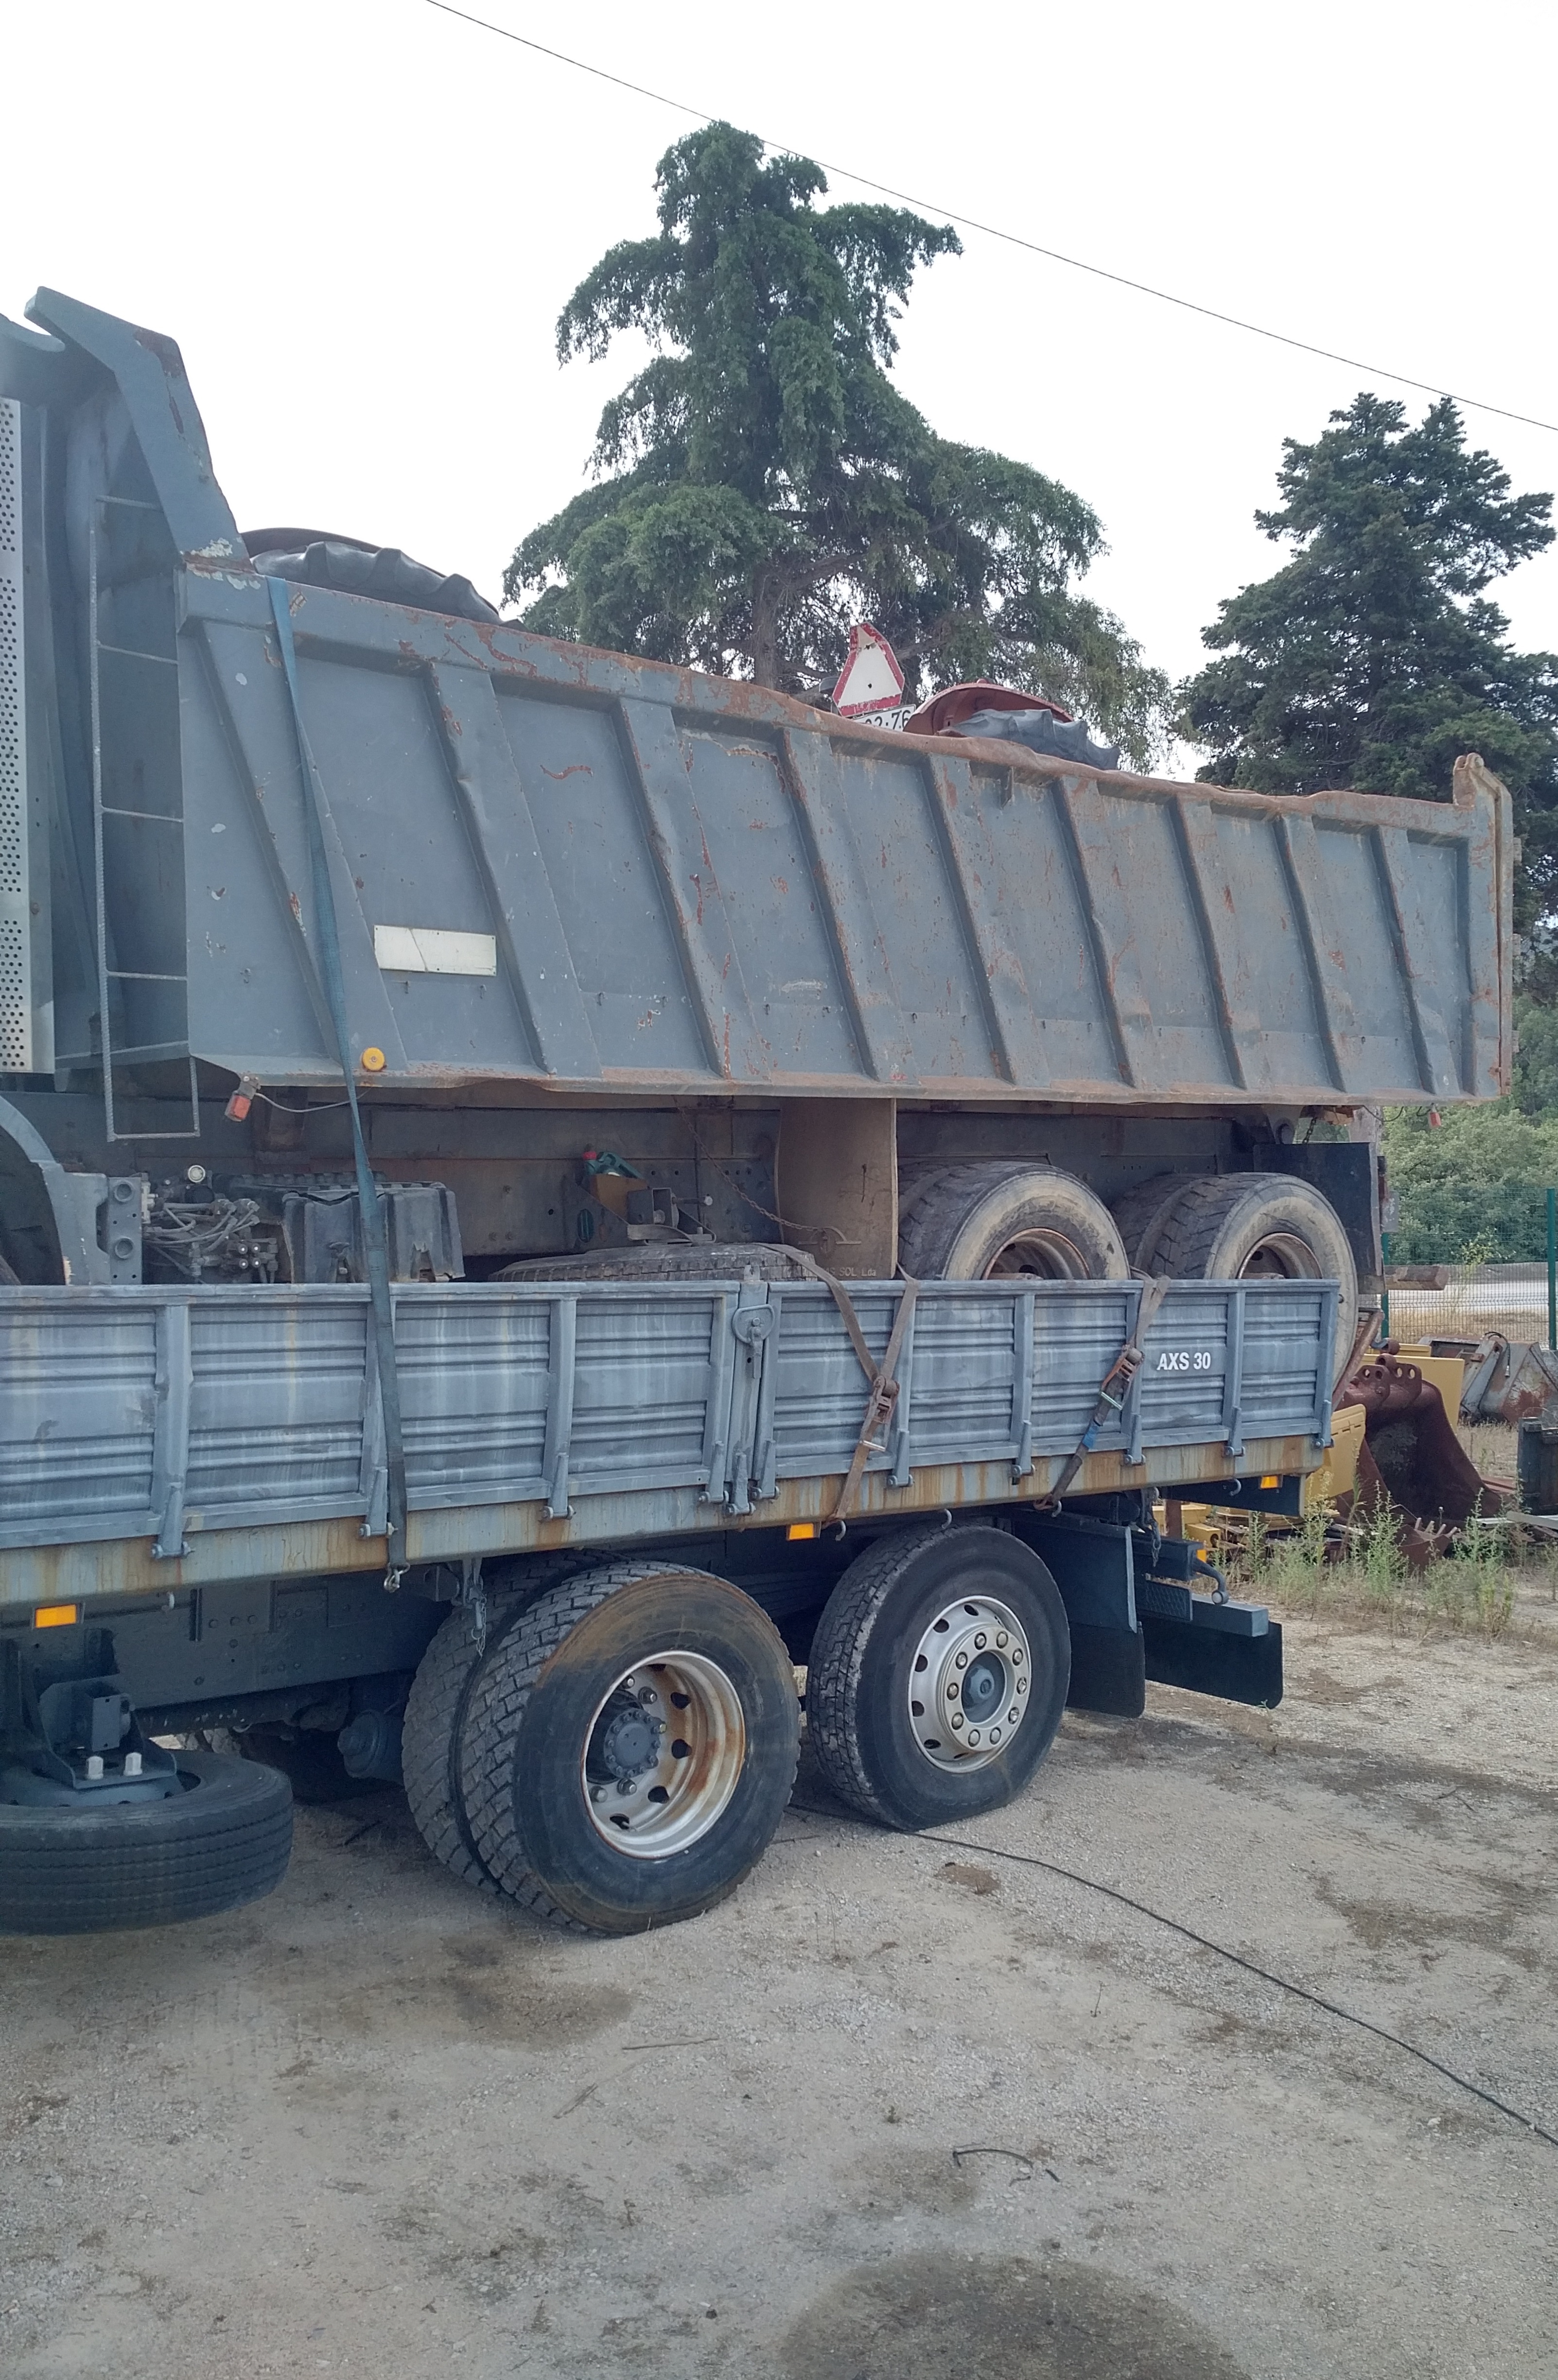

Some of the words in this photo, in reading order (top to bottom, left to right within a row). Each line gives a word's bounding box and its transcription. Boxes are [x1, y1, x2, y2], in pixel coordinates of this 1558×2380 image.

[840, 1267, 858, 1277] SOL
[861, 1268, 877, 1277] Lda
[1156, 1352, 1190, 1370] AXS
[1193, 1352, 1211, 1370] 30
